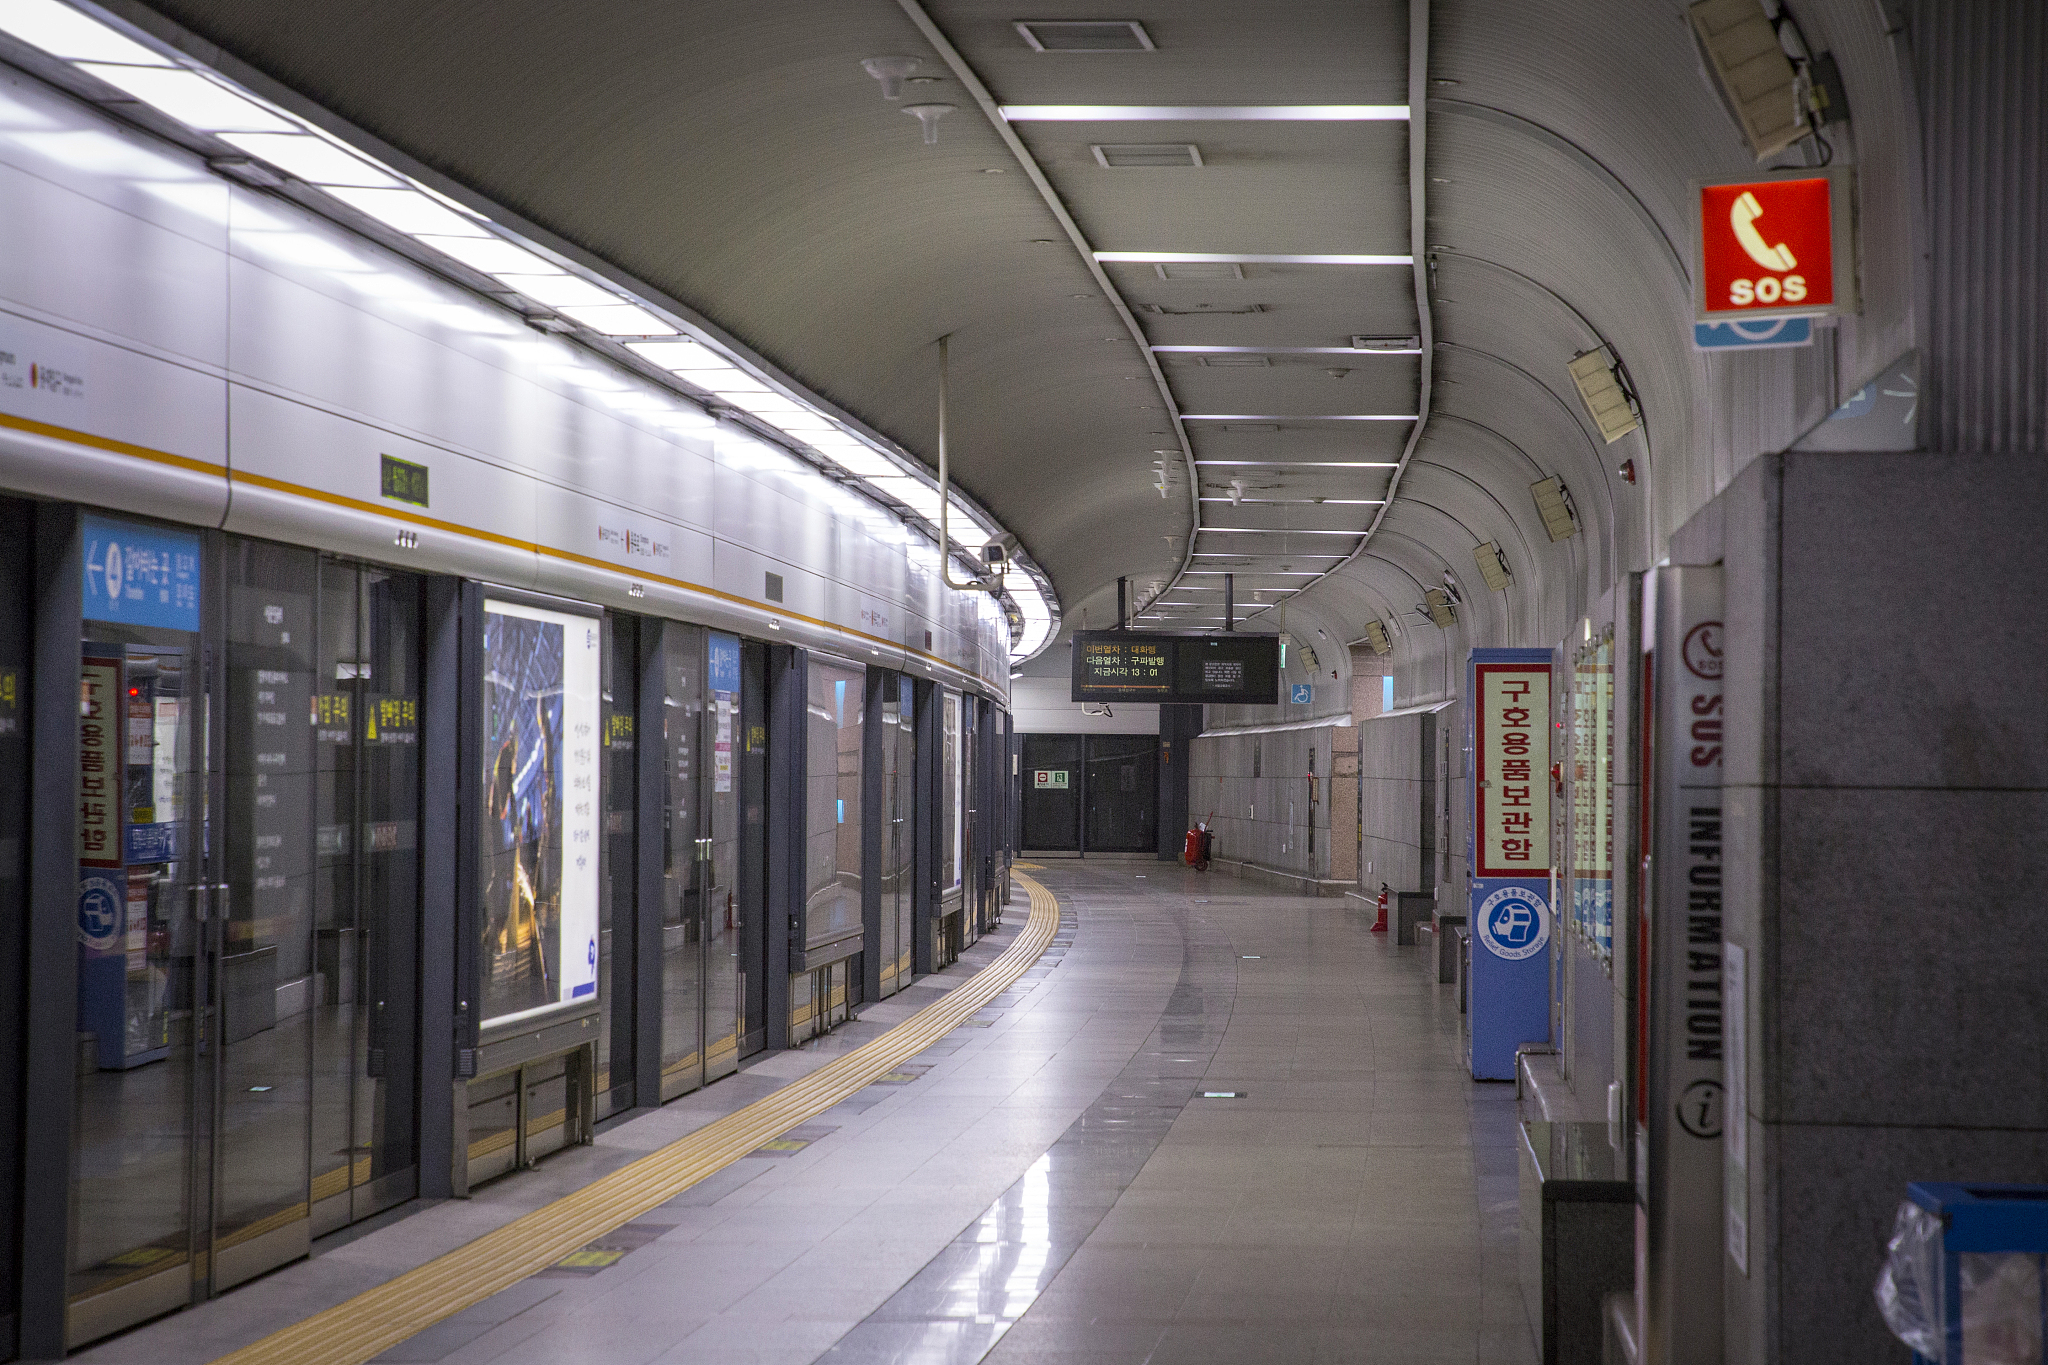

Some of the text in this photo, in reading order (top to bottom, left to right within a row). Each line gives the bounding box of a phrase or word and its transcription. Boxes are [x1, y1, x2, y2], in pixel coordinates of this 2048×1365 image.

[1729, 275, 1808, 306] SOS
[1086, 645, 1120, 654] 이번열차
[1131, 645, 1156, 654] 대화행
[1086, 656, 1120, 666] 다음열차
[1131, 656, 1165, 666] 구파발행
[1094, 667, 1128, 676] 지금시각
[1132, 668, 1140, 676] 13
[1149, 668, 1158, 676] 01
[1501, 680, 1533, 861] 구호용품보관함
[1486, 888, 1542, 908] 구호용품보관함
[1483, 934, 1544, 958] Relief Goods Storage
